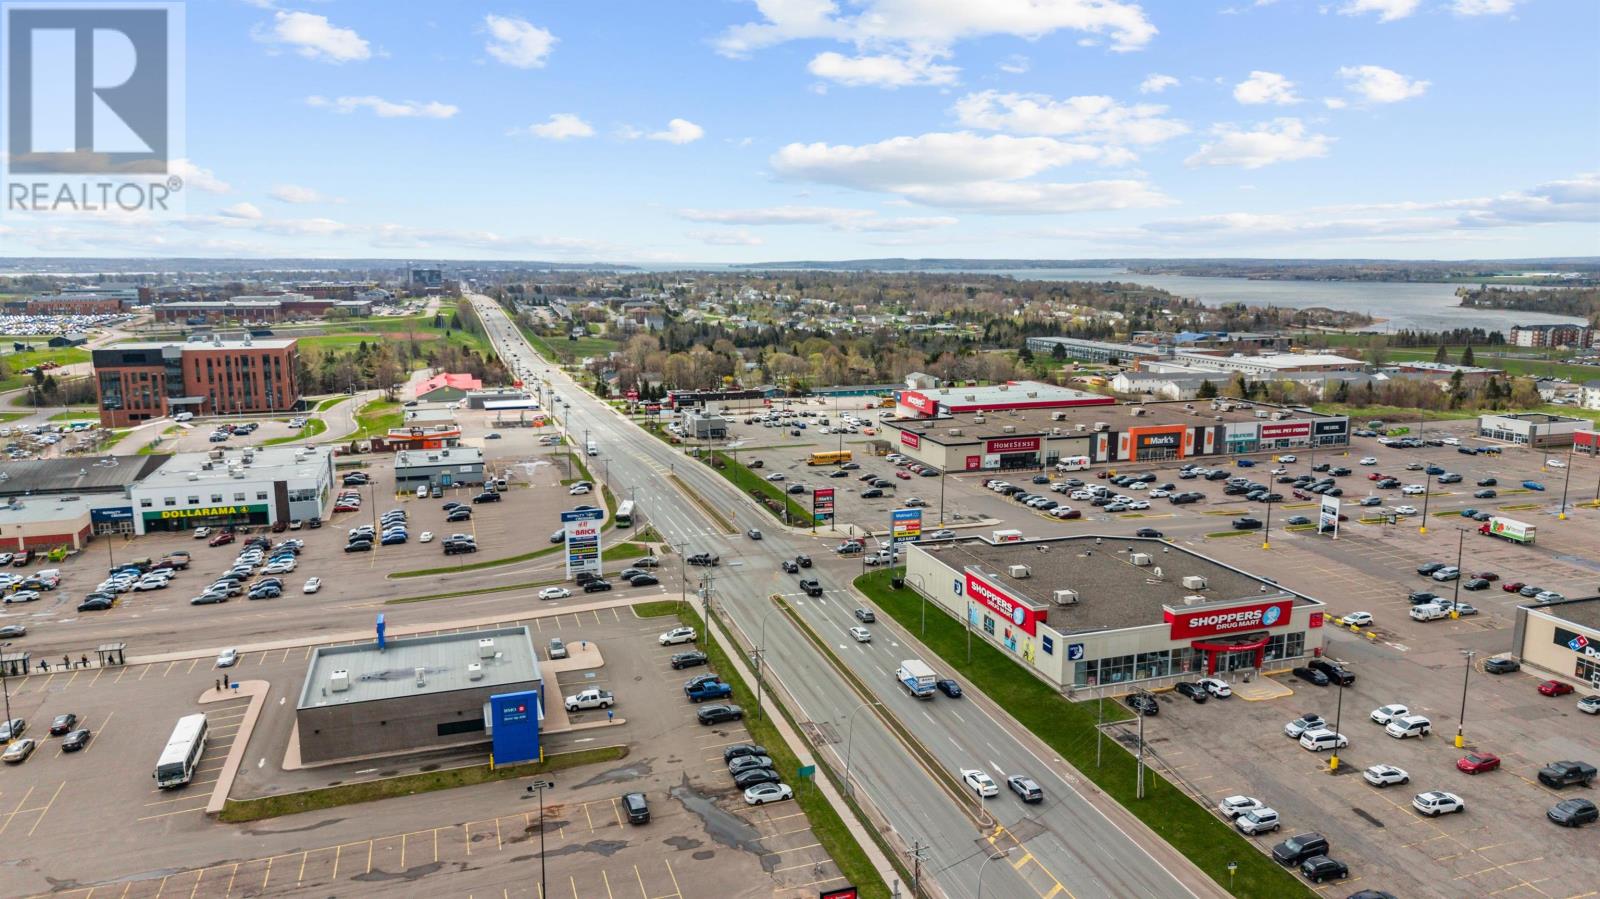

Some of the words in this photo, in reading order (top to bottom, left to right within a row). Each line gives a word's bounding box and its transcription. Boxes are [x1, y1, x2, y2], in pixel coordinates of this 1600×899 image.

[1151, 436, 1174, 444] Mark's
[1071, 458, 1087, 466] FedEx
[162, 507, 236, 518] DOLLARAMA
[971, 581, 1013, 612] SHOPPERS
[1189, 609, 1262, 628] SHOPPERS
[1216, 622, 1238, 630] DRUG
[1238, 619, 1259, 627] MART
